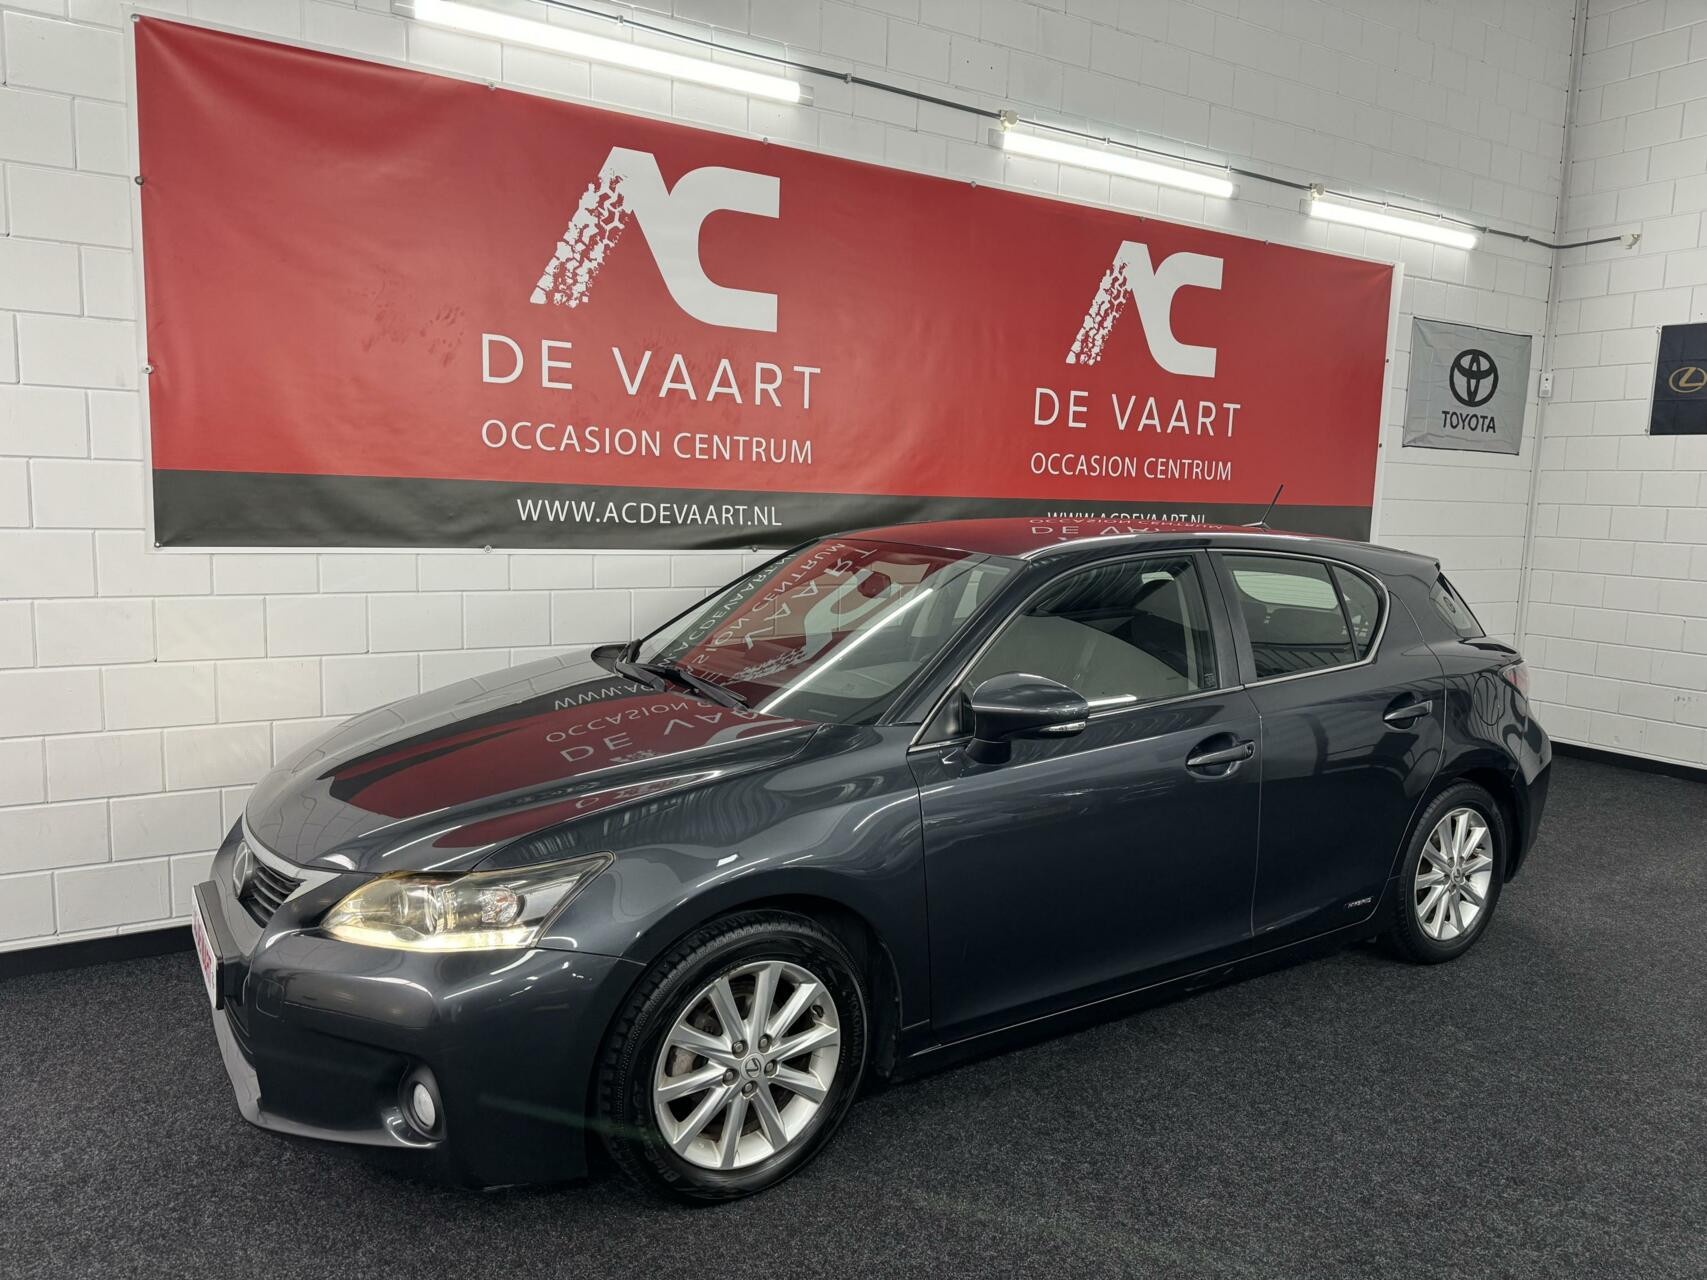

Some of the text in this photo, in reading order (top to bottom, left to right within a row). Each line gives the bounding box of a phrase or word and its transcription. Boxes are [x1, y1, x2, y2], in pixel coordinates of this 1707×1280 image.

[481, 333, 821, 409] DE VAART
[1034, 387, 1241, 437] DE VAART
[1441, 410, 1497, 434] TOYOTA
[481, 419, 813, 465] OCCASION CENTRUM
[1030, 452, 1232, 481] OCCASION CENTRUM
[516, 498, 782, 526] WWW.ACDEVAART.NL
